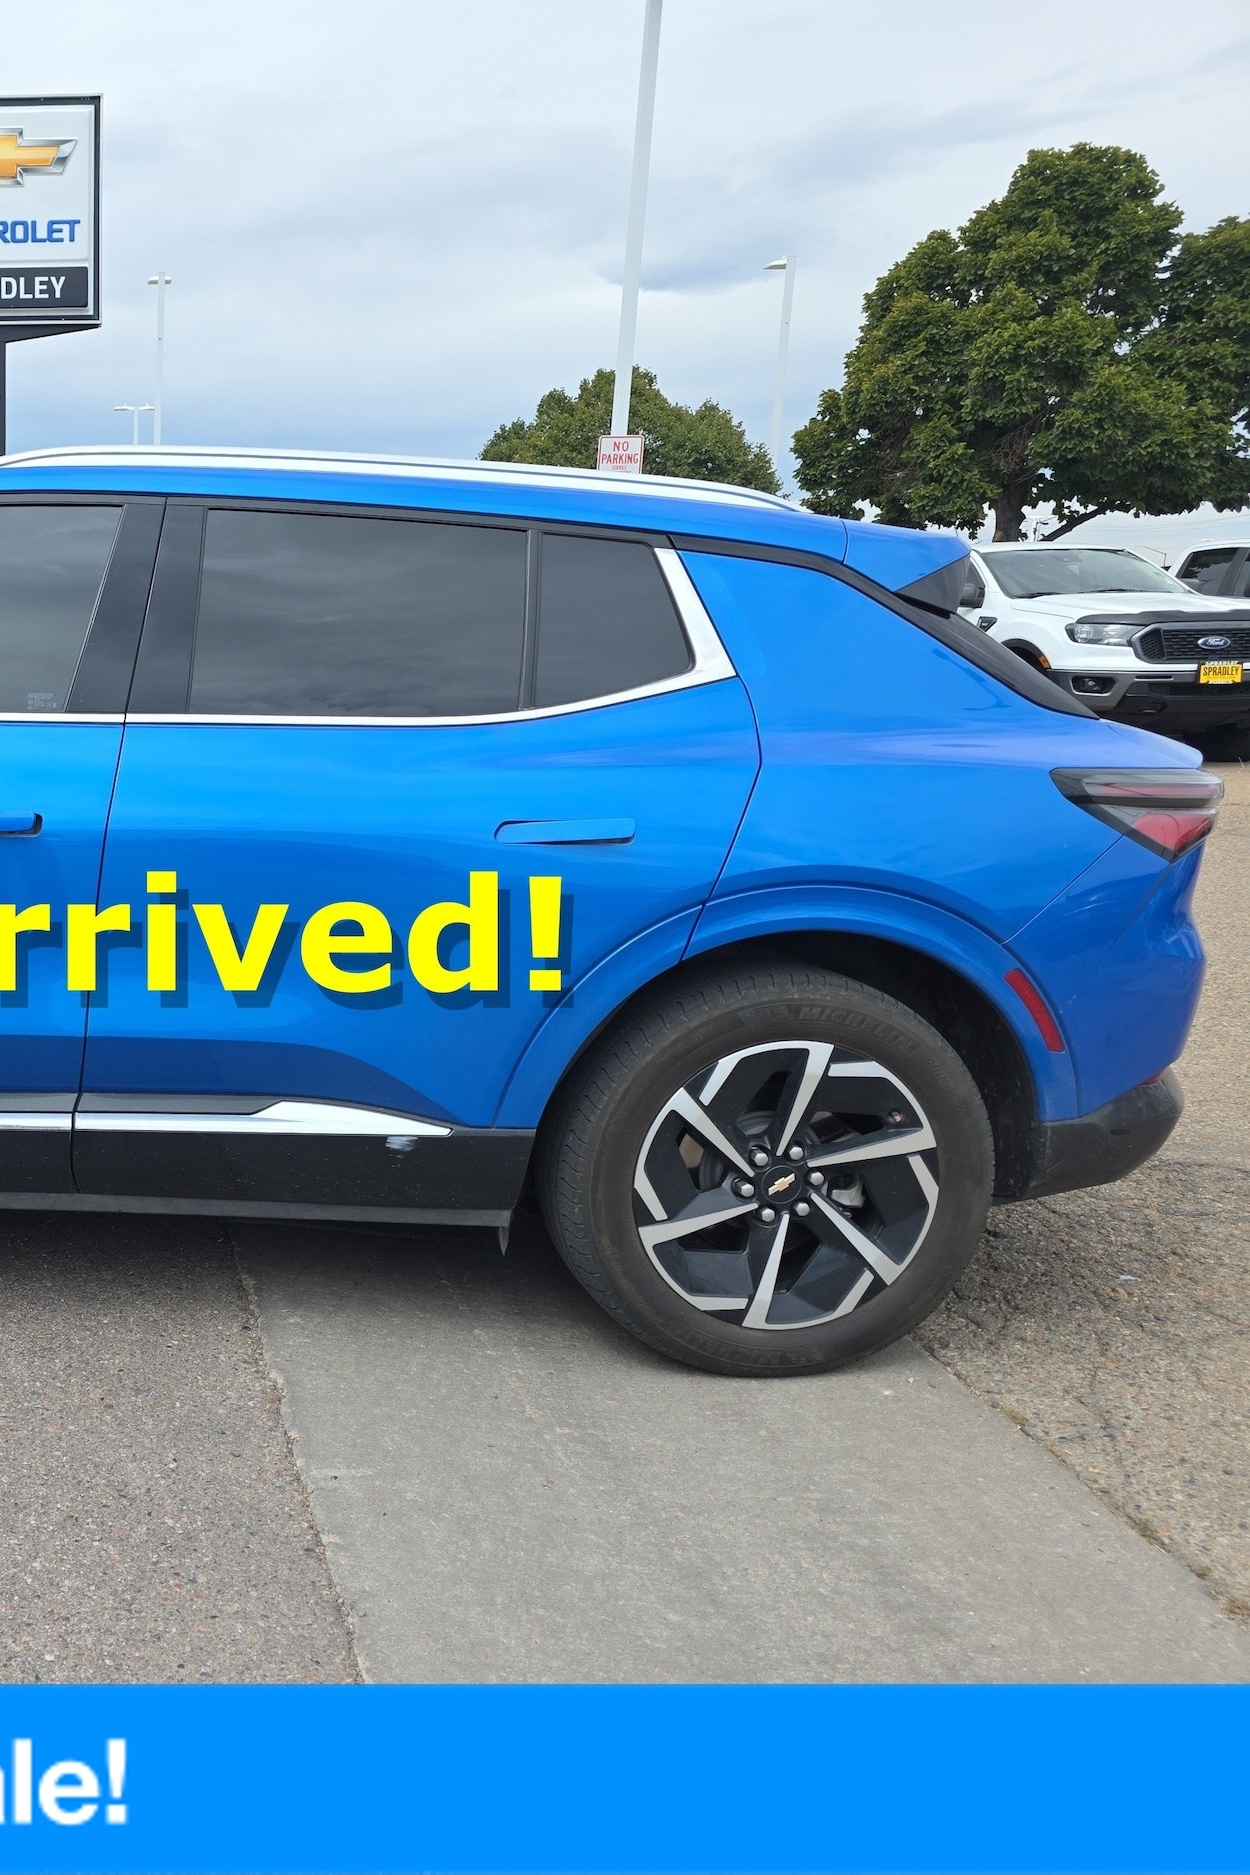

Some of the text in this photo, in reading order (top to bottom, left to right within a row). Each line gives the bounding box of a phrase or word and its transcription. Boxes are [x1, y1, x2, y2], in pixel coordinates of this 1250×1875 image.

[613, 441, 629, 451] NO
[601, 453, 639, 464] PARKING
[1203, 666, 1240, 676] SPRADLEY
[800, 1006, 915, 1055] MICHELIN
